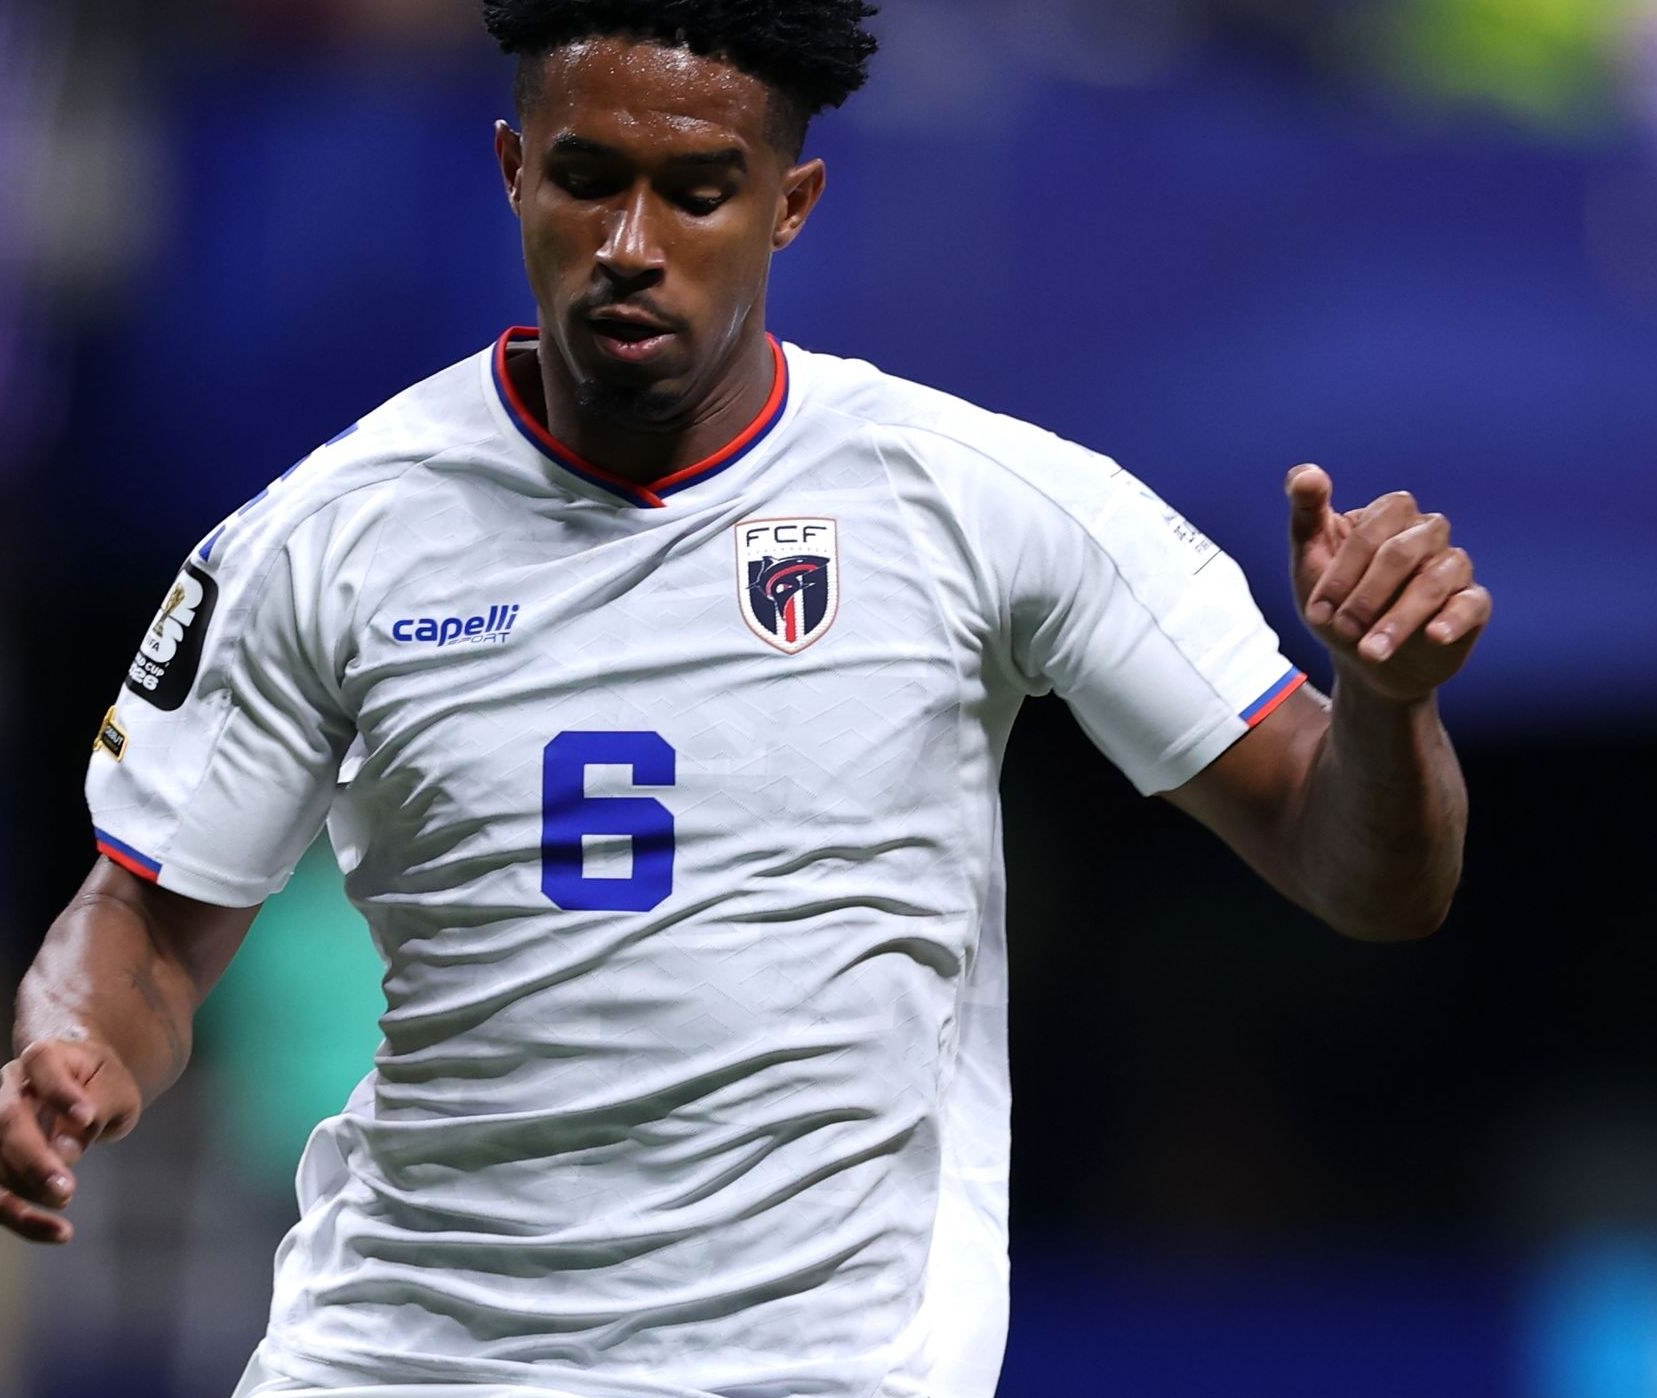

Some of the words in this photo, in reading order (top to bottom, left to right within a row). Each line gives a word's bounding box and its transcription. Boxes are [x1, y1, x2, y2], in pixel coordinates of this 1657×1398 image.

[746, 525, 827, 547] FCF
[392, 604, 520, 647] capelli
[144, 662, 164, 676] CUP
[541, 731, 676, 912] 6
